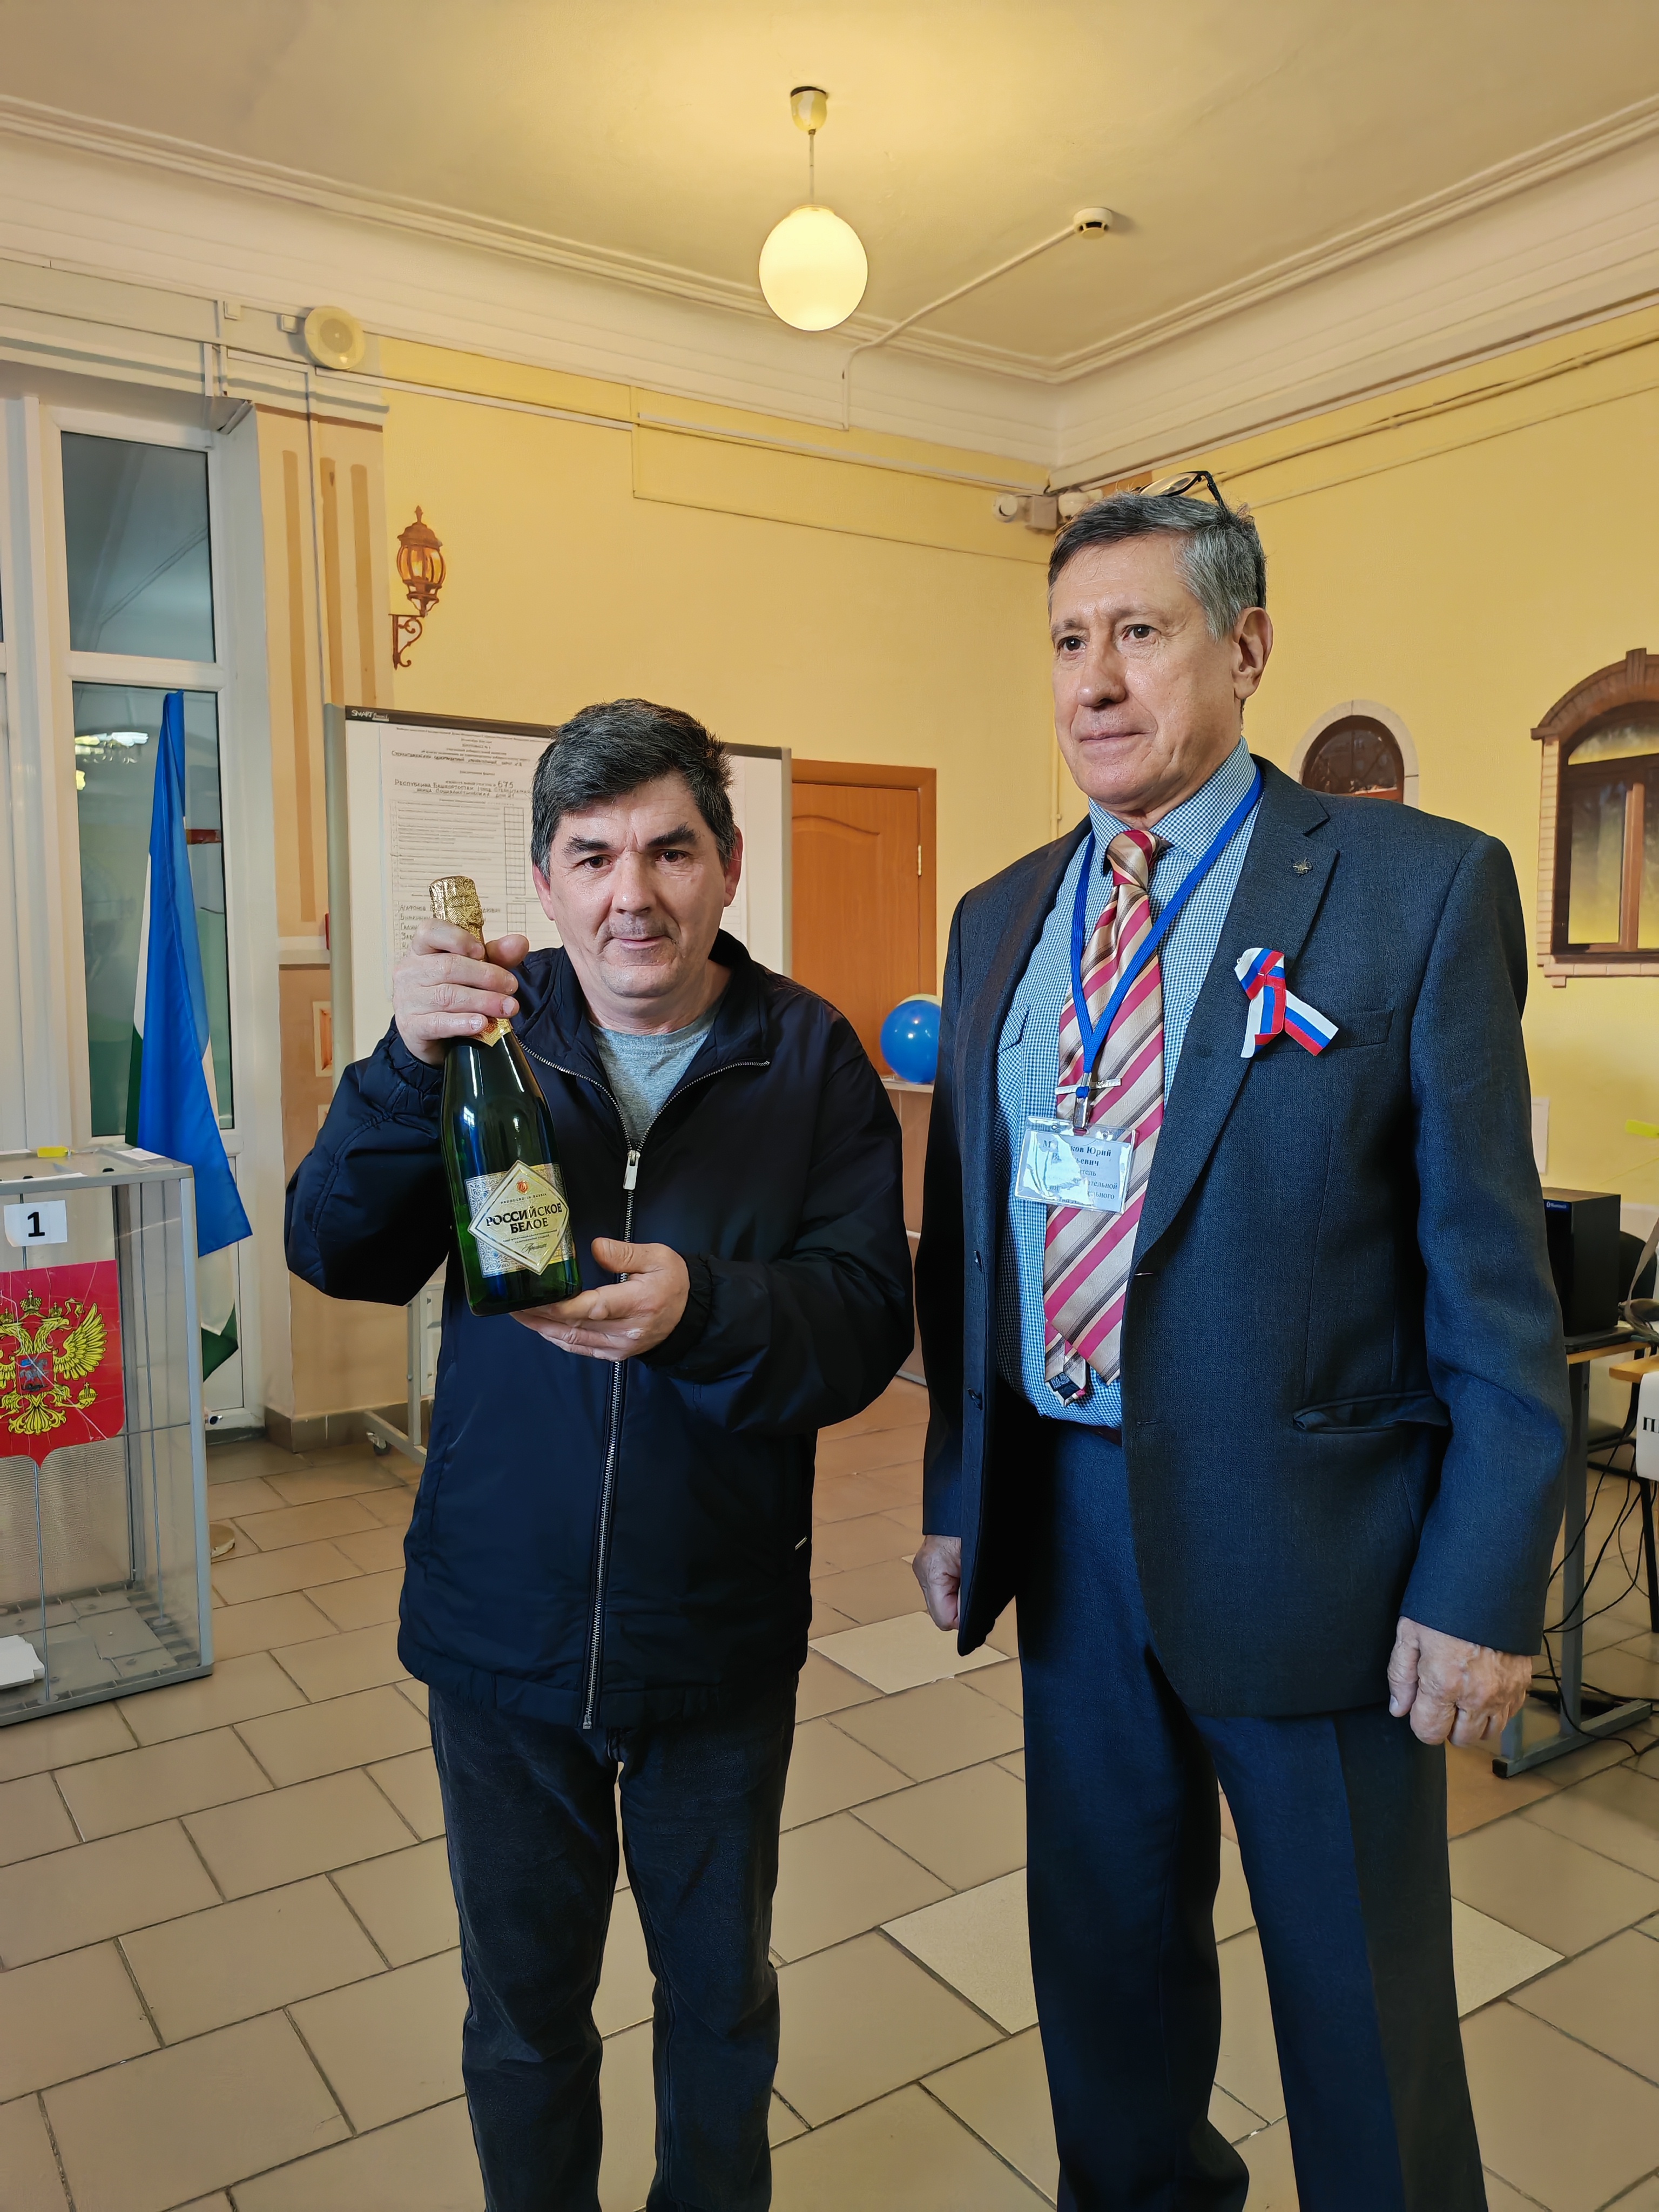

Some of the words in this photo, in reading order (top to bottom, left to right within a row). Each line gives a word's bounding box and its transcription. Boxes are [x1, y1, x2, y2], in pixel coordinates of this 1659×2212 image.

[351, 709, 373, 718] SMART
[1086, 1145, 1112, 1158] Юрий
[485, 1202, 563, 1227] РОССИЙСКОЕ
[26, 1211, 46, 1238] 1
[509, 1217, 549, 1235] БЕЛОЕ
